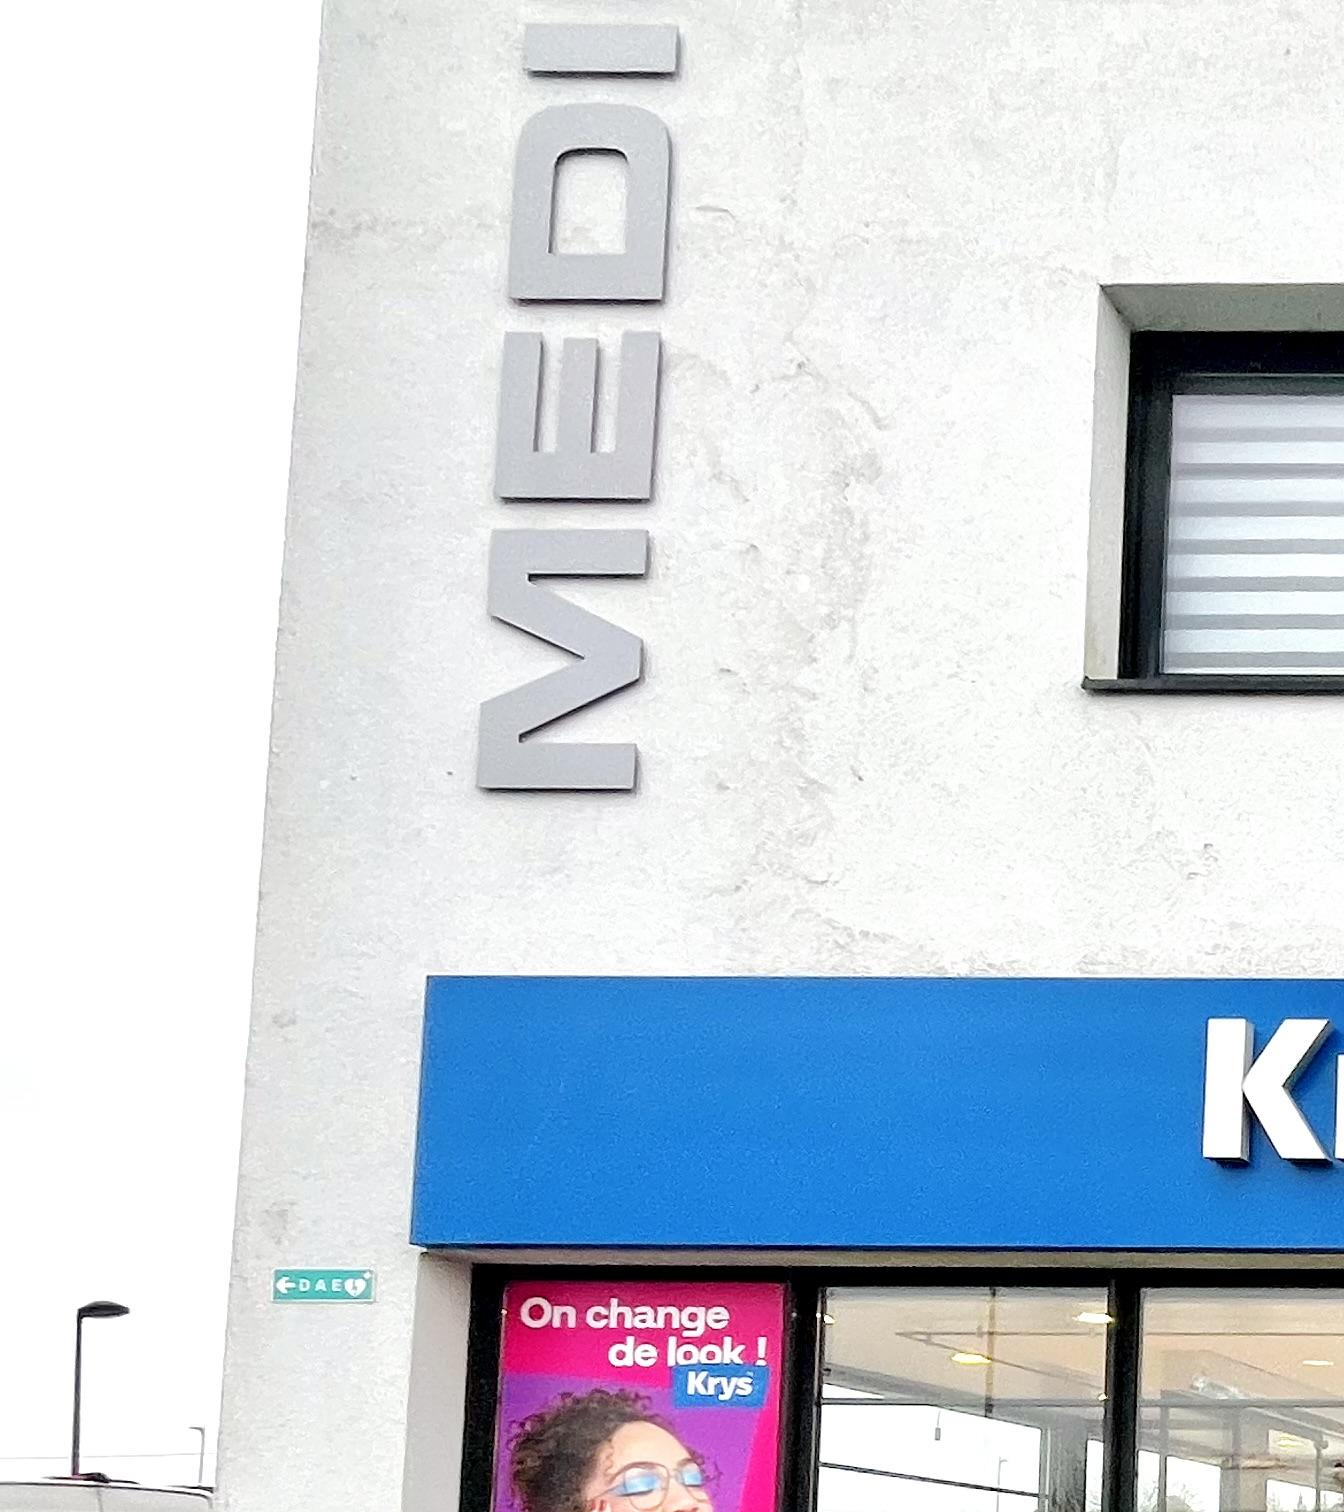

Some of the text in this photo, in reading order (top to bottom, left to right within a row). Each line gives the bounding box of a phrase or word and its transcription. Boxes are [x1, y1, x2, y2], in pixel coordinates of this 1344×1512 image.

[299, 1278, 342, 1292] DAE
[520, 1297, 730, 1337] On change
[608, 1336, 659, 1367] de
[667, 1336, 745, 1367] look
[687, 1370, 753, 1400] Krys
